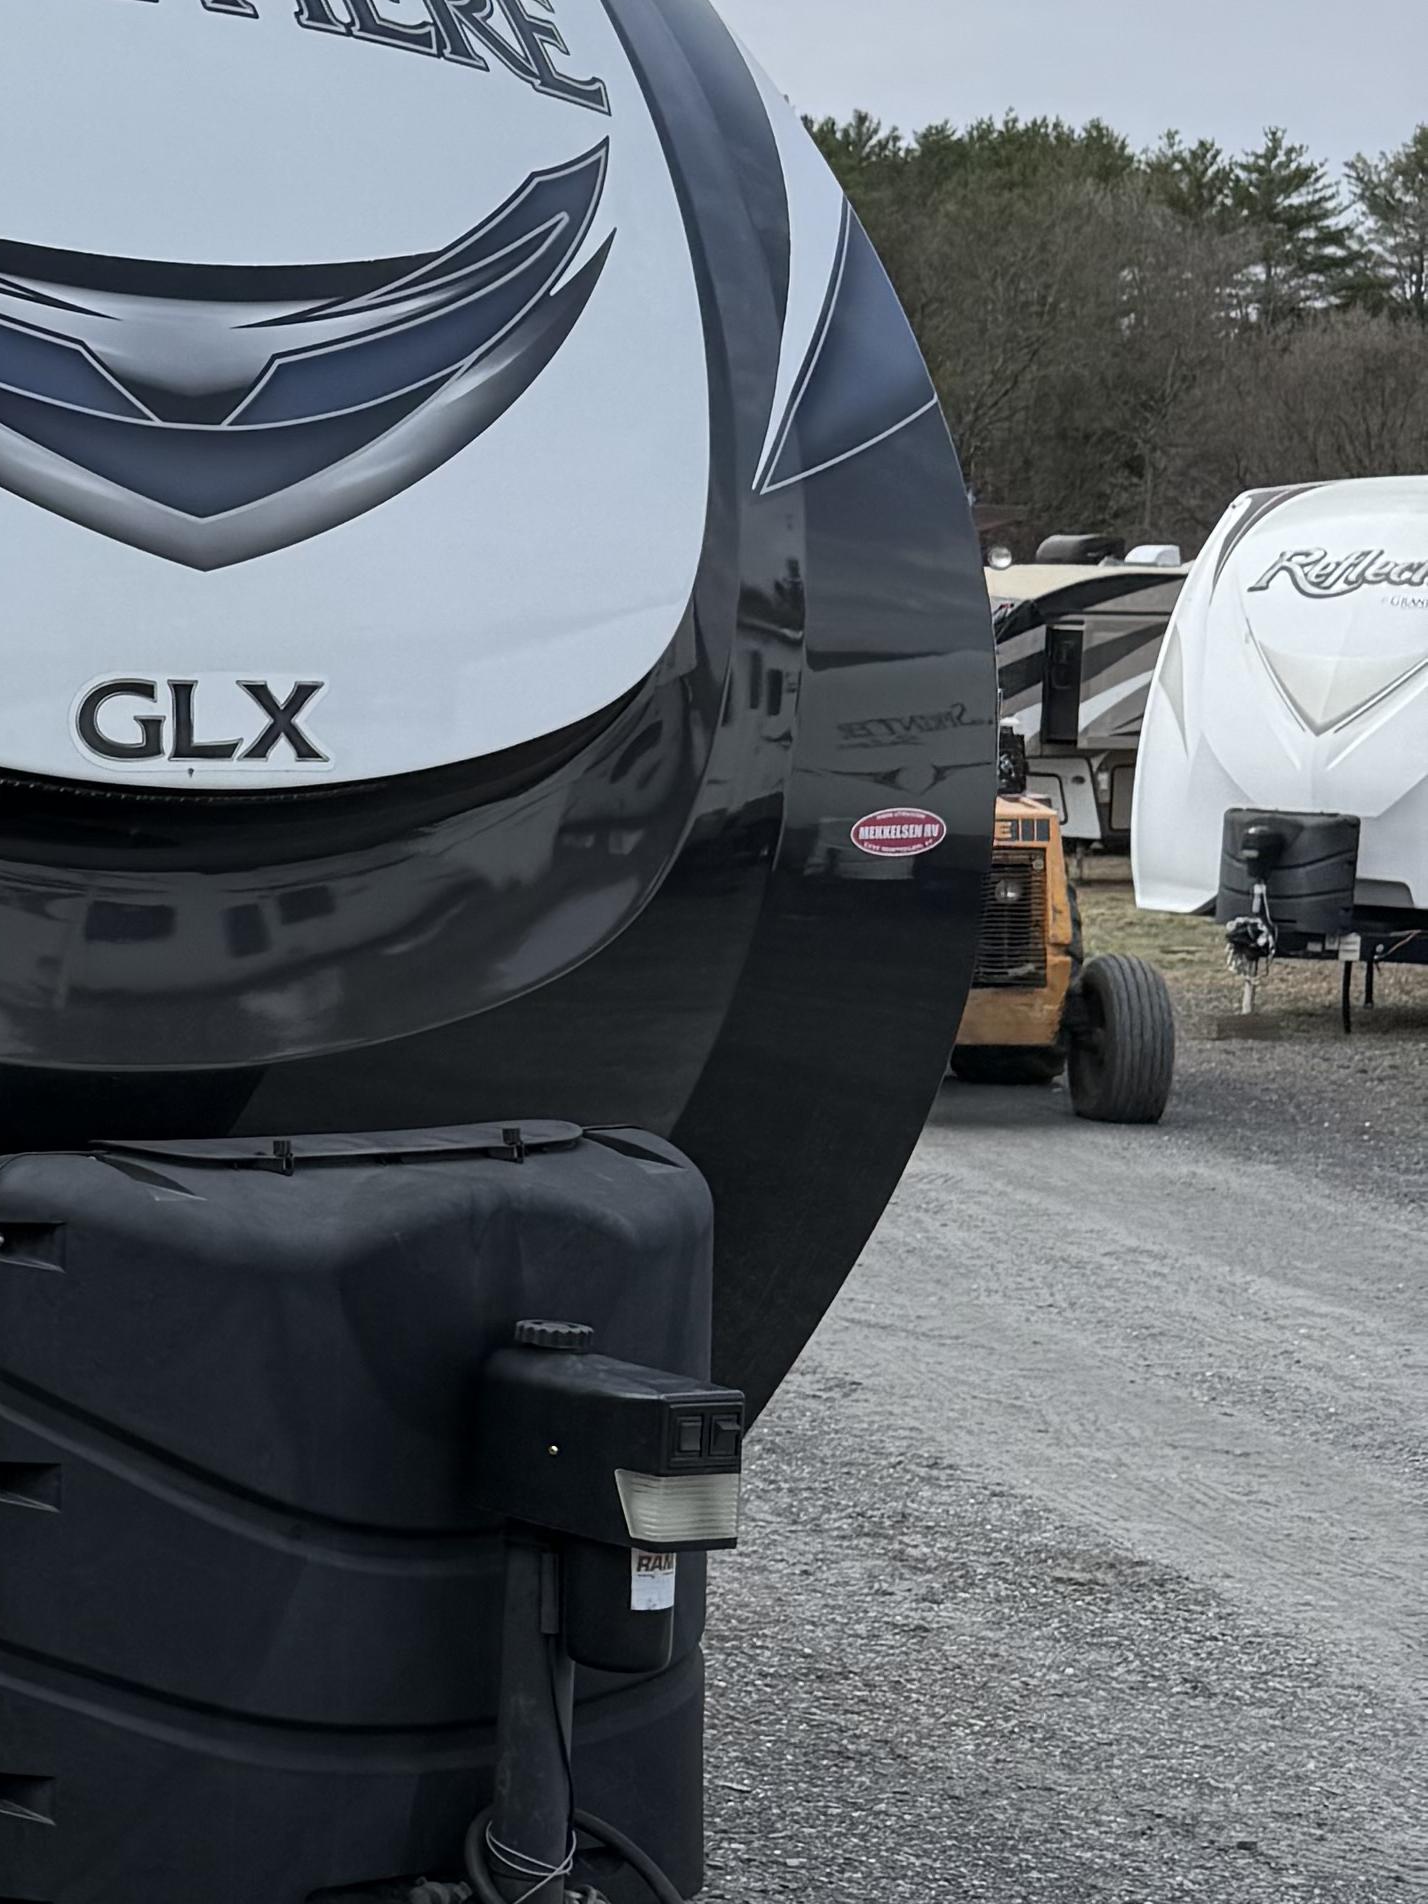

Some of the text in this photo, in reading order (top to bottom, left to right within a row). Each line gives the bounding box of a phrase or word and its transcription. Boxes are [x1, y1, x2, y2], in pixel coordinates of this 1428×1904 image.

[75, 677, 330, 762] GLX
[858, 823, 940, 840] MEKKELSEN RV
